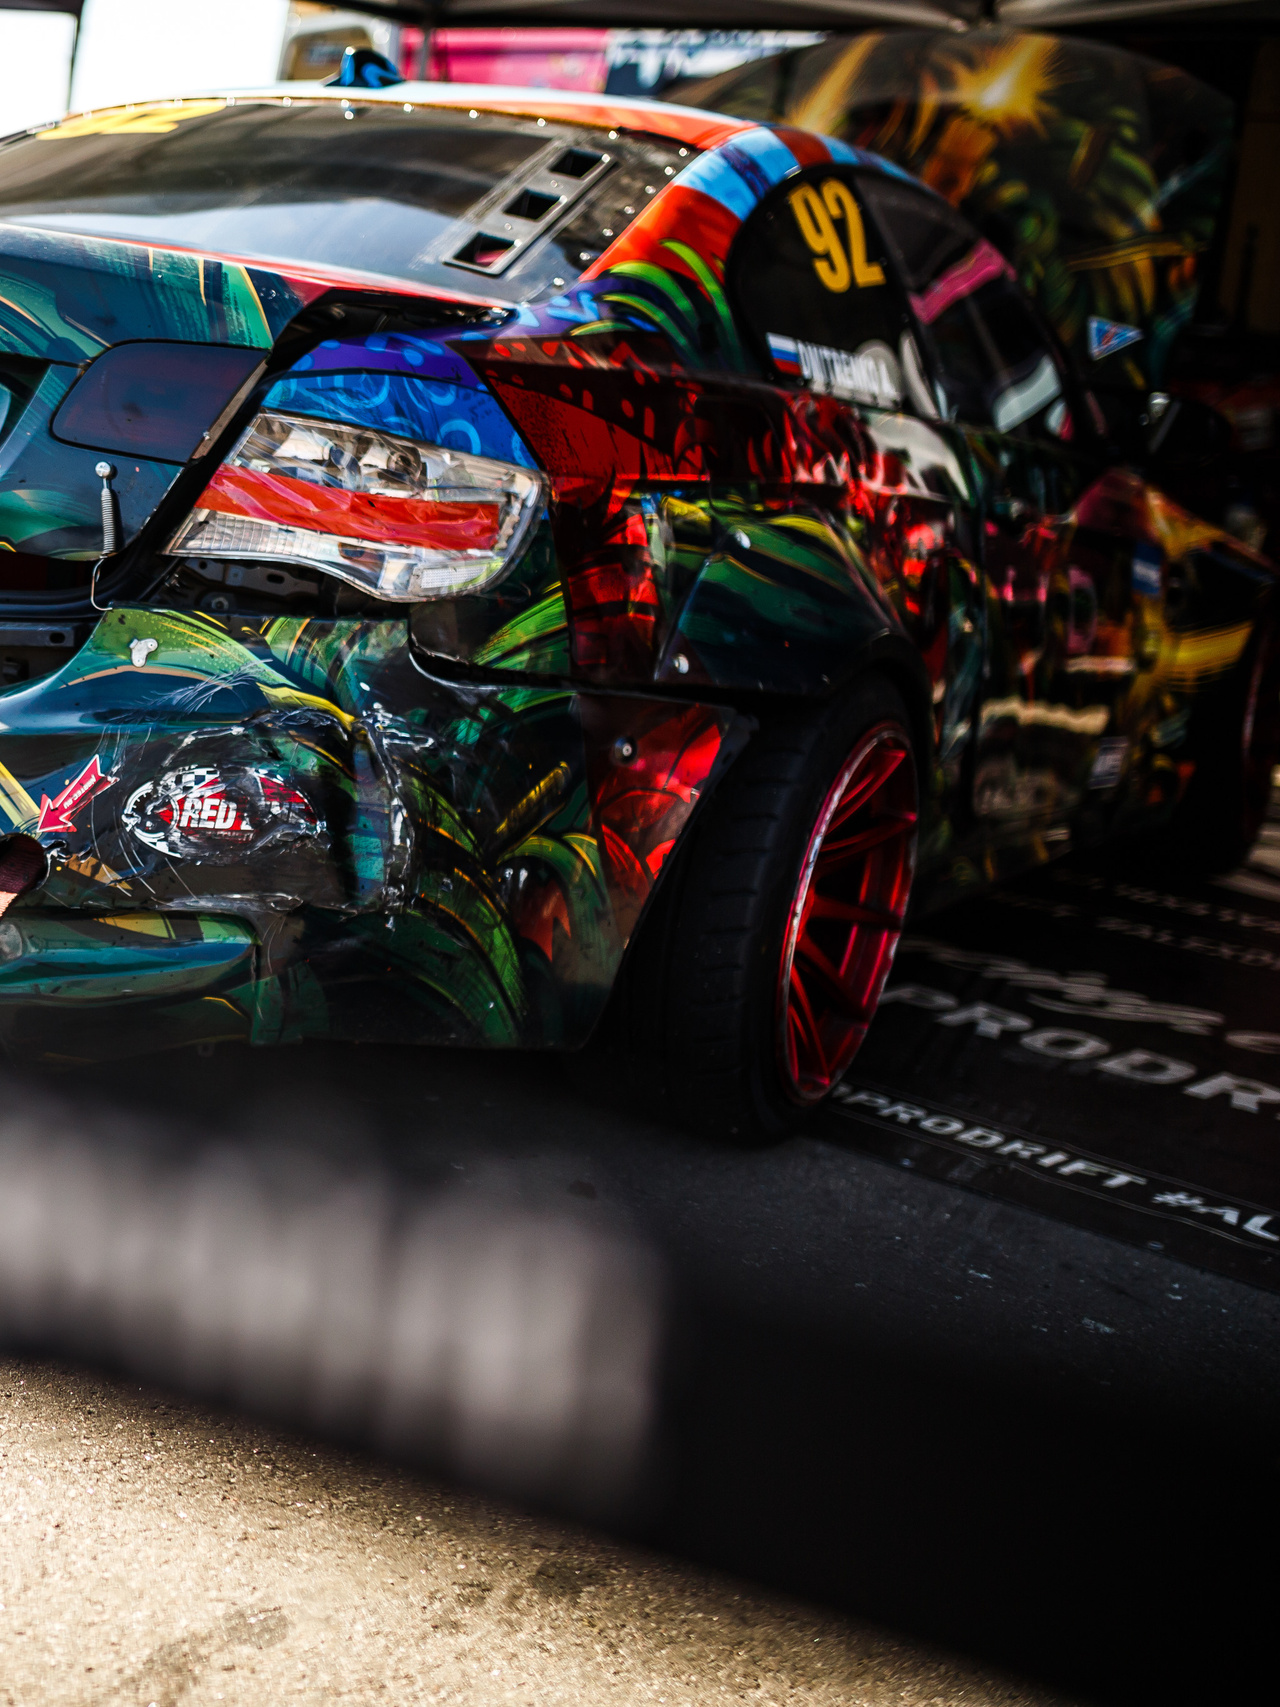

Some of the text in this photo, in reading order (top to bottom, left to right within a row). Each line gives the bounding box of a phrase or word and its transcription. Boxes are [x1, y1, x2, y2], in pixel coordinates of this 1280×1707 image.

[789, 180, 886, 293] 92
[179, 798, 237, 830] RED
[878, 984, 1280, 1119] PRODR
[1151, 1189, 1280, 1242] #AL
